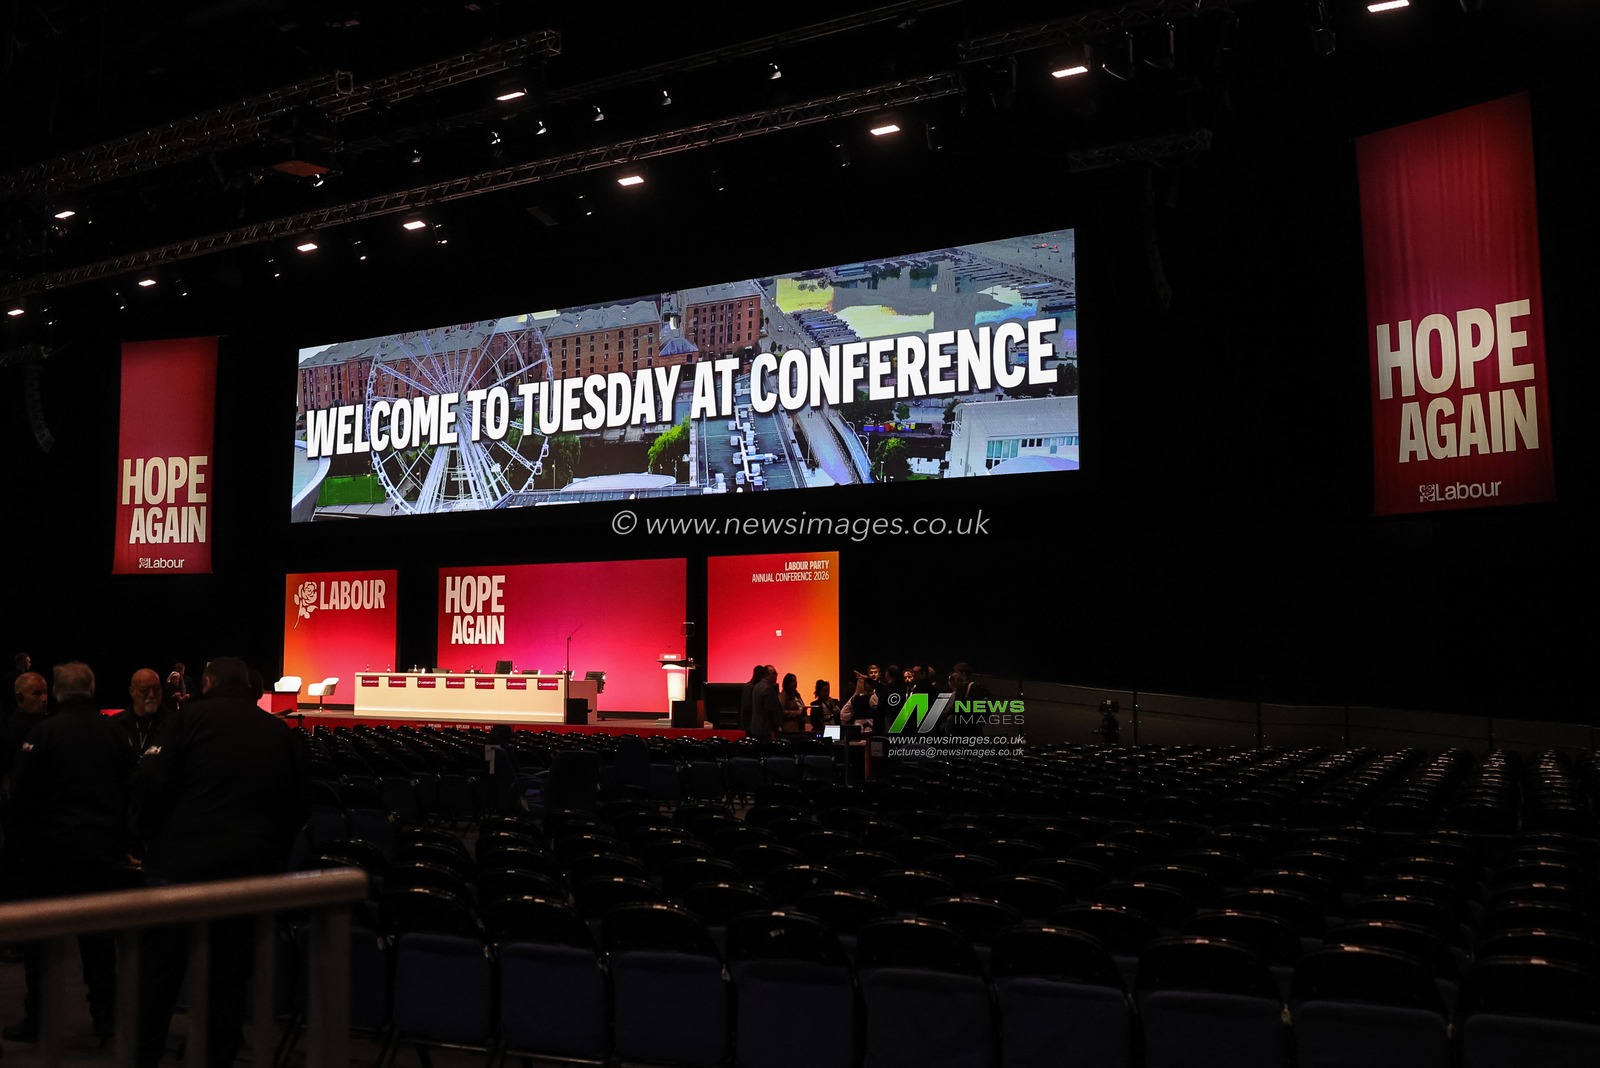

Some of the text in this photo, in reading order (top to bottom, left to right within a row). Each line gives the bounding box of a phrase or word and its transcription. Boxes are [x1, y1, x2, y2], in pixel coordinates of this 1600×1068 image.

[1376, 298, 1535, 400] HOPE
[306, 317, 1059, 459] WELCOME TO TUESDAY AT CONFERENCE
[1399, 385, 1540, 463] AGAIN
[121, 455, 208, 505] HOPE
[1435, 481, 1502, 501] Labour
[129, 505, 207, 545] AGAIN
[148, 557, 185, 569] Labour
[751, 571, 829, 582] ANNUAL CONFERENCE 2026
[784, 560, 829, 570] LABOUR PARTY
[319, 579, 386, 610] LABOUR
[445, 574, 506, 614] HOPE
[451, 615, 505, 645] AGAIN
